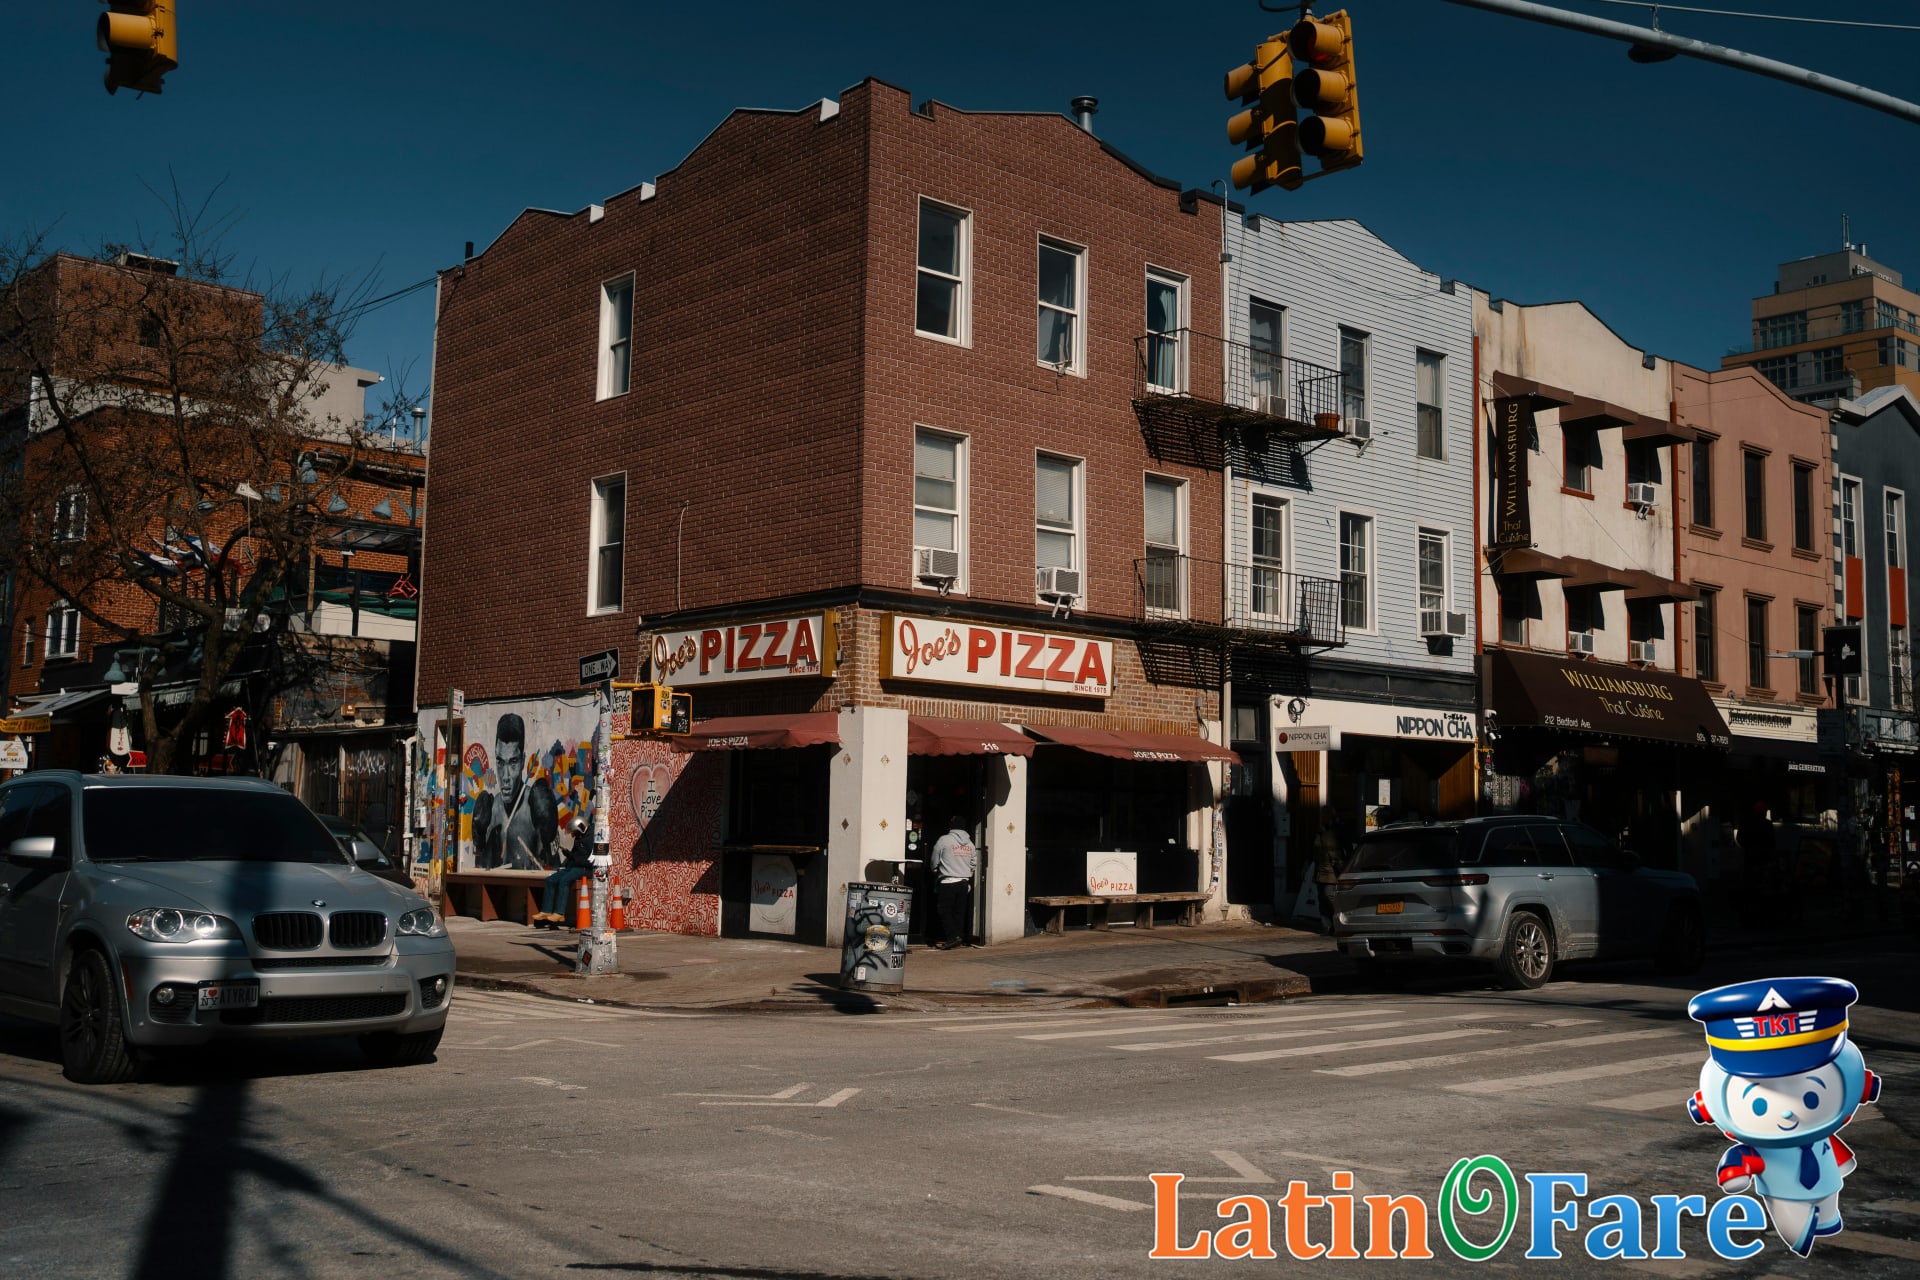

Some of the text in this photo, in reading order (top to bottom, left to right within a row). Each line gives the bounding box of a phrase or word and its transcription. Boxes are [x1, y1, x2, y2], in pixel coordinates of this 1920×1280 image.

[1506, 403, 1518, 516] WILLIAMSBURG
[1503, 520, 1521, 531] Thai
[1499, 531, 1530, 543] Cuisine
[654, 618, 818, 684] Joe's PIZZA
[899, 619, 1107, 686] Joe's PIZZA
[584, 659, 613, 676] ONE WAY
[788, 665, 806, 674] SINCE
[1074, 684, 1093, 693] SINCE
[1560, 668, 1674, 701] WILLIAMSBURG
[1598, 696, 1665, 721] Thai Cuisine
[1544, 714, 1555, 725] 212
[1556, 715, 1580, 728] Bedford
[1396, 715, 1474, 740] NIPPON CHA
[707, 736, 749, 747] JOE'S PIZZA
[1288, 732, 1312, 741] NIPPON
[980, 742, 999, 751] 216
[1133, 750, 1181, 760] JOE'S PIZZA
[647, 780, 656, 792] I
[641, 791, 662, 805] Love
[771, 887, 794, 898] PIZZA
[1110, 882, 1134, 891] PIZZA
